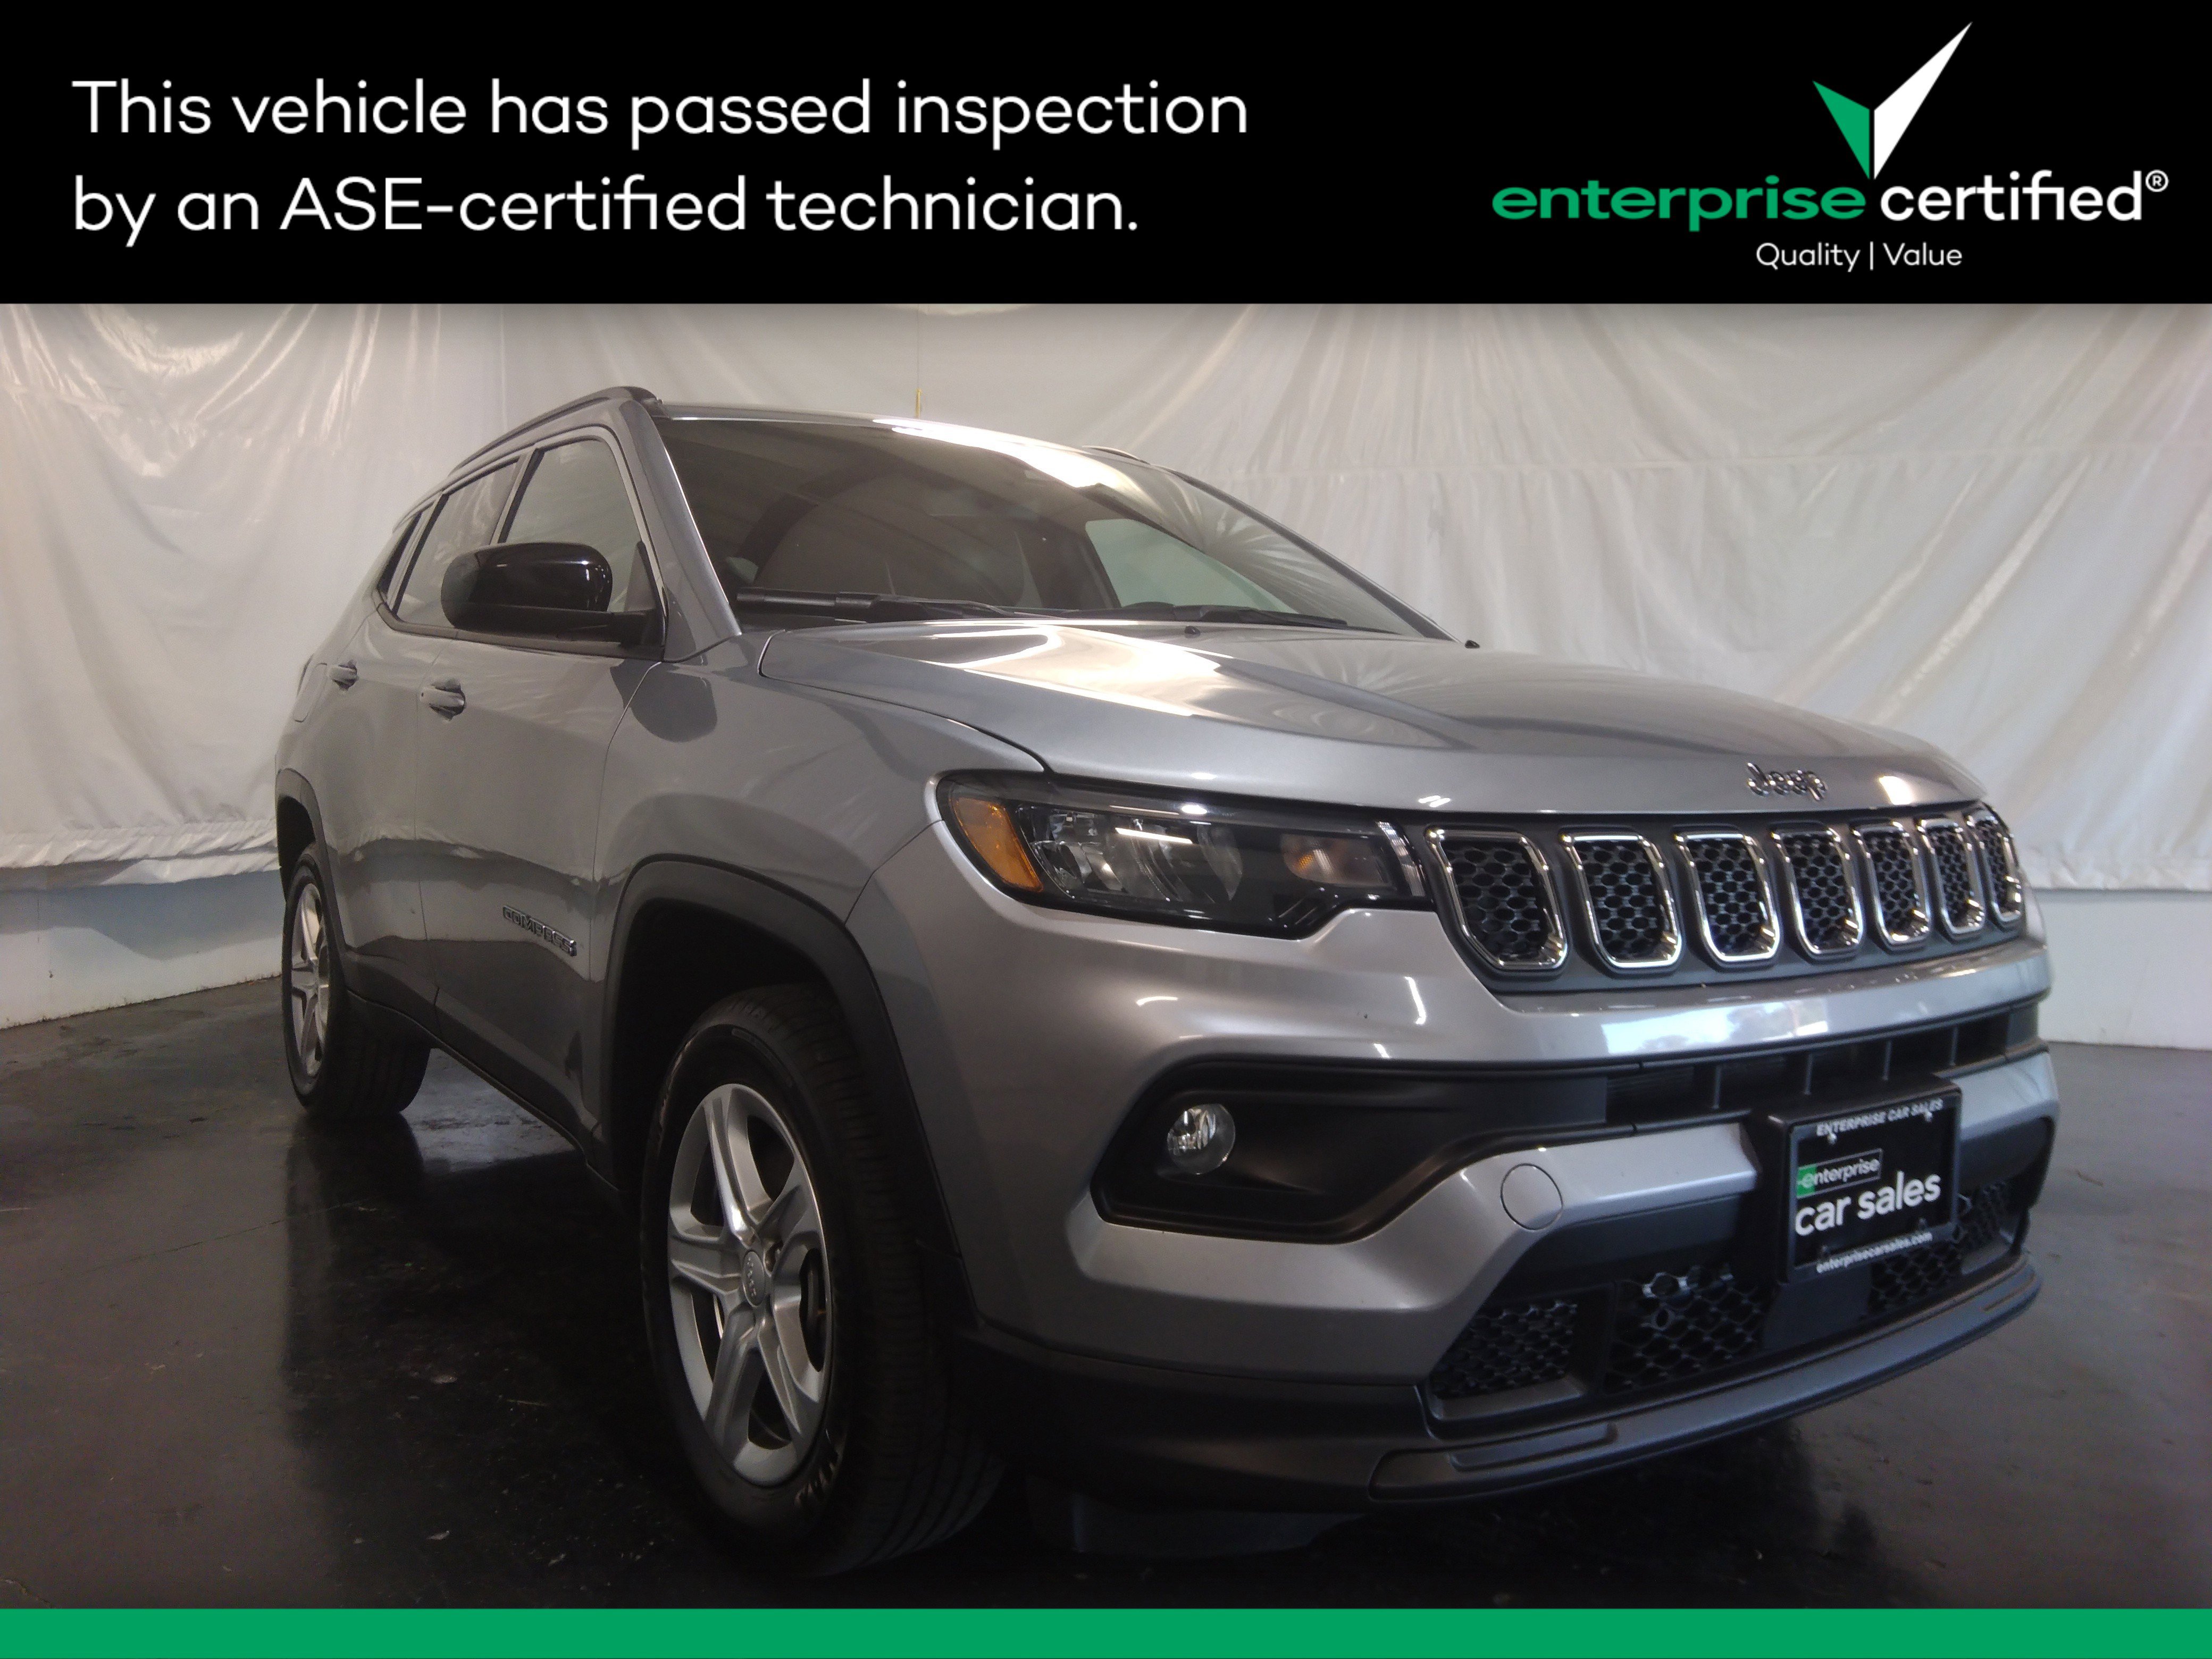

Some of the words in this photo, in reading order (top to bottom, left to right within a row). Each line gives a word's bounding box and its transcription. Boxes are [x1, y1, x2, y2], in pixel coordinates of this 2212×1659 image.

[1746, 763, 1828, 802] Jeep
[1798, 1159, 1880, 1188] enterprise
[1795, 1195, 1851, 1236] car
[1857, 1171, 1941, 1220] sales
